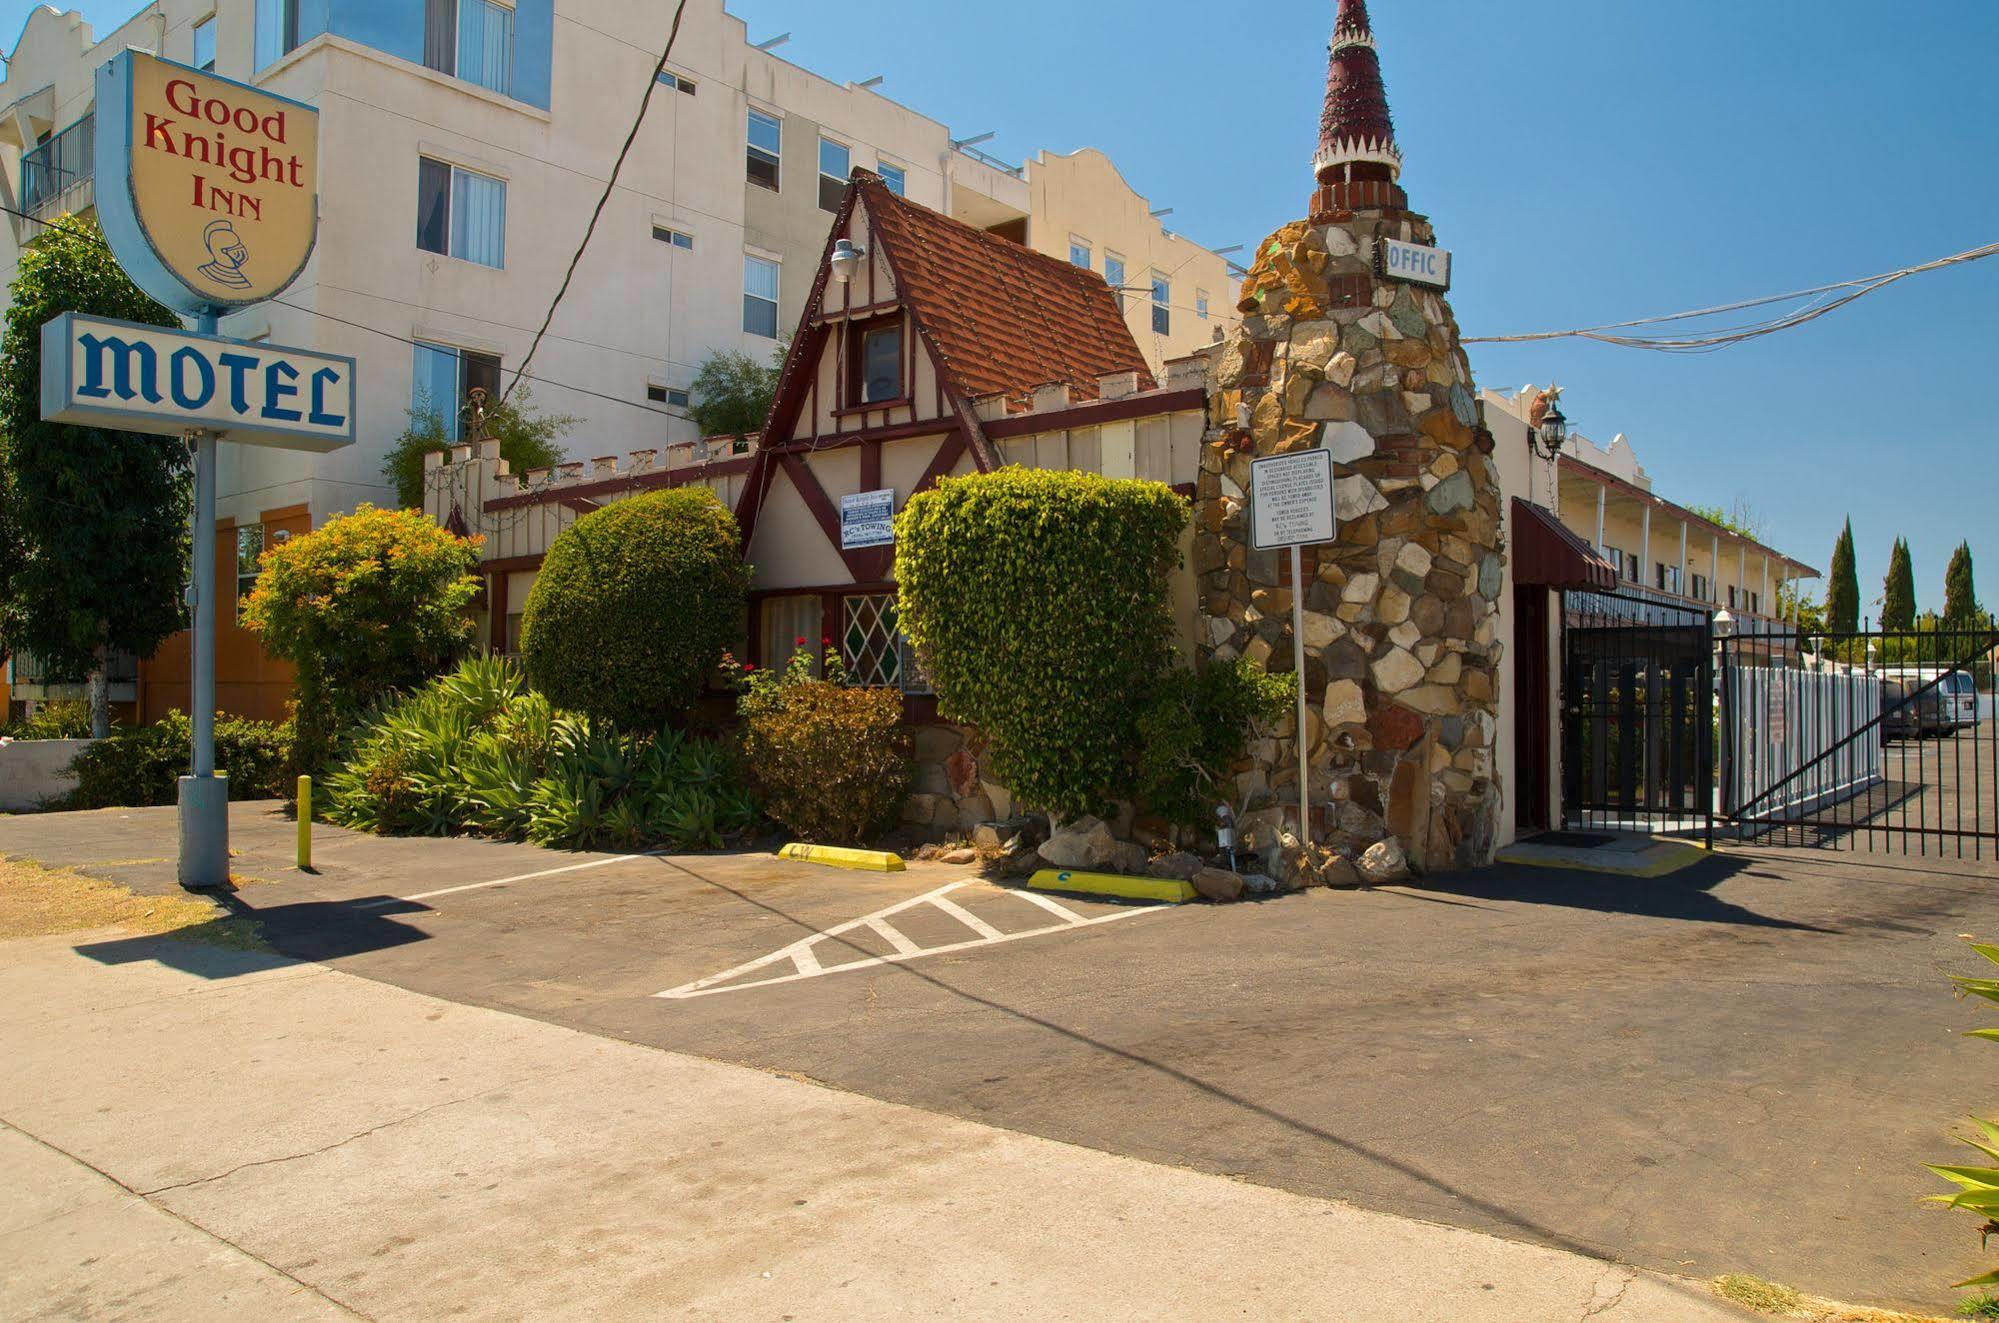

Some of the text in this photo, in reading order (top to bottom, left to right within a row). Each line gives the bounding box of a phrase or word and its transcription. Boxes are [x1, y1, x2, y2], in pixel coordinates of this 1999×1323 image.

[165, 79, 286, 144] Good
[143, 112, 304, 187] Knight
[191, 173, 262, 222] INN
[1389, 246, 1436, 275] OFFIC
[76, 332, 346, 428] MOTEL
[861, 523, 892, 532] TOWING
